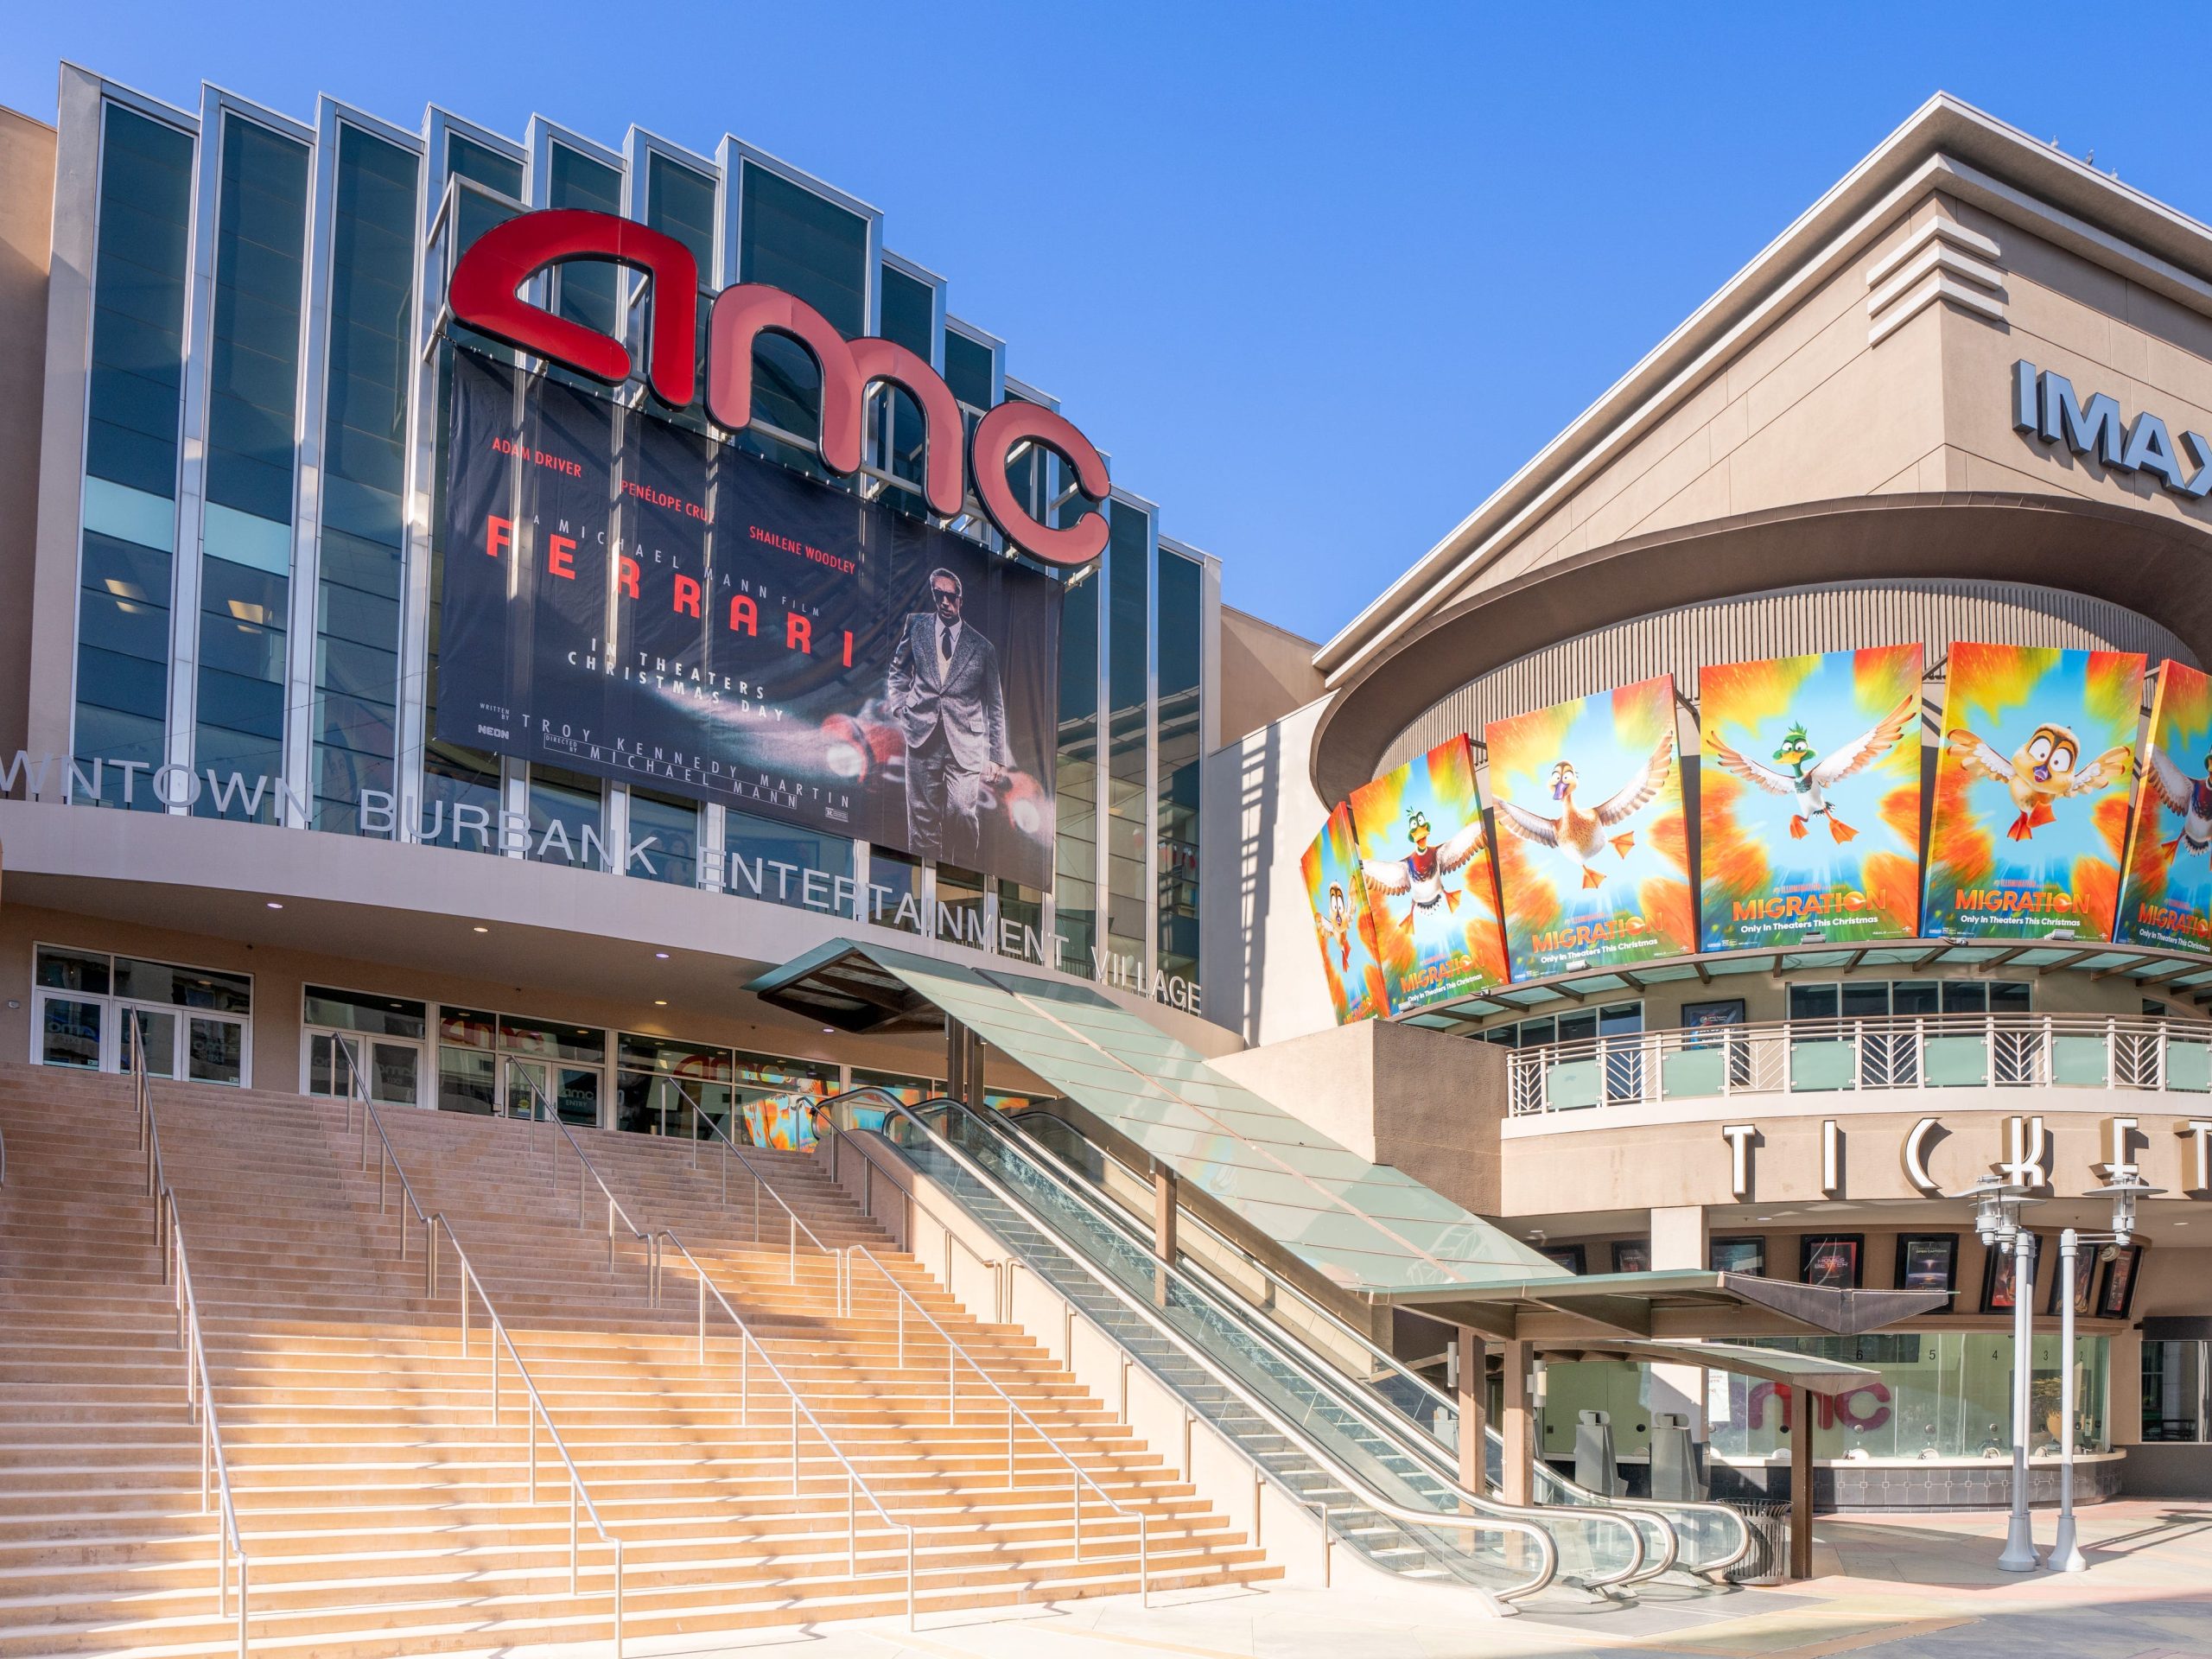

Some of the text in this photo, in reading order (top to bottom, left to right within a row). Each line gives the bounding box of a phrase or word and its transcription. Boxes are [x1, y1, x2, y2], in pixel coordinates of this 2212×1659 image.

[446, 208, 1111, 568] amc
[493, 437, 582, 478] ADAM DRIVER
[621, 479, 682, 512] PENÉLOPE
[533, 514, 819, 617] A MICHAEL MANN FILM
[749, 525, 855, 575] SHAILENE WOODLEY
[486, 514, 853, 668] FERRARI
[591, 638, 764, 700] IN THEATERS
[568, 652, 783, 722] CHRISTMAS DAY
[480, 702, 510, 715] WRITTEN
[478, 724, 510, 740] NEON
[545, 734, 578, 747] DIRECTED
[522, 714, 849, 808] TROY KENNEDY MARTIN
[590, 746, 796, 808] MICHAEL MANN
[360, 788, 658, 875] BURBANK
[698, 846, 1070, 966] ENTERTAINMENT
[1091, 945, 1202, 1014] VILLAGE
[1732, 888, 1886, 922] MIGRATION
[1955, 888, 2090, 914] MIGRATION
[1532, 912, 1663, 954] MIGRATION
[1740, 916, 1878, 934] Only In Theaters This Christmas
[1961, 915, 1980, 925] Only
[1989, 916, 2024, 925] Theaters
[2024, 917, 2040, 925] This
[2041, 918, 2081, 926] Christmas
[2138, 902, 2212, 940] MIGRATIO
[1541, 955, 1559, 965] Only
[1567, 947, 1600, 960] Theaters
[1601, 945, 1617, 954] This
[1618, 938, 1658, 951] Christmas
[2139, 929, 2152, 938] Only
[2157, 933, 2177, 944] Theaters
[2177, 938, 2187, 946] This
[2187, 941, 2210, 951] Christmas
[1401, 950, 1485, 994] MIGRATION
[1425, 985, 1446, 997] Theaters
[1446, 982, 1456, 990] This
[1456, 974, 1483, 986] Christmas
[563, 1088, 594, 1100] amc
[1722, 1116, 2212, 1195] TICKET
[1856, 1350, 1863, 1360] 6
[1929, 1350, 1936, 1360] 5
[1992, 1351, 1998, 1360] 4
[2044, 1351, 2049, 1361] 3
[2080, 1351, 2083, 1361] 2
[1715, 1382, 1891, 1432] mc
